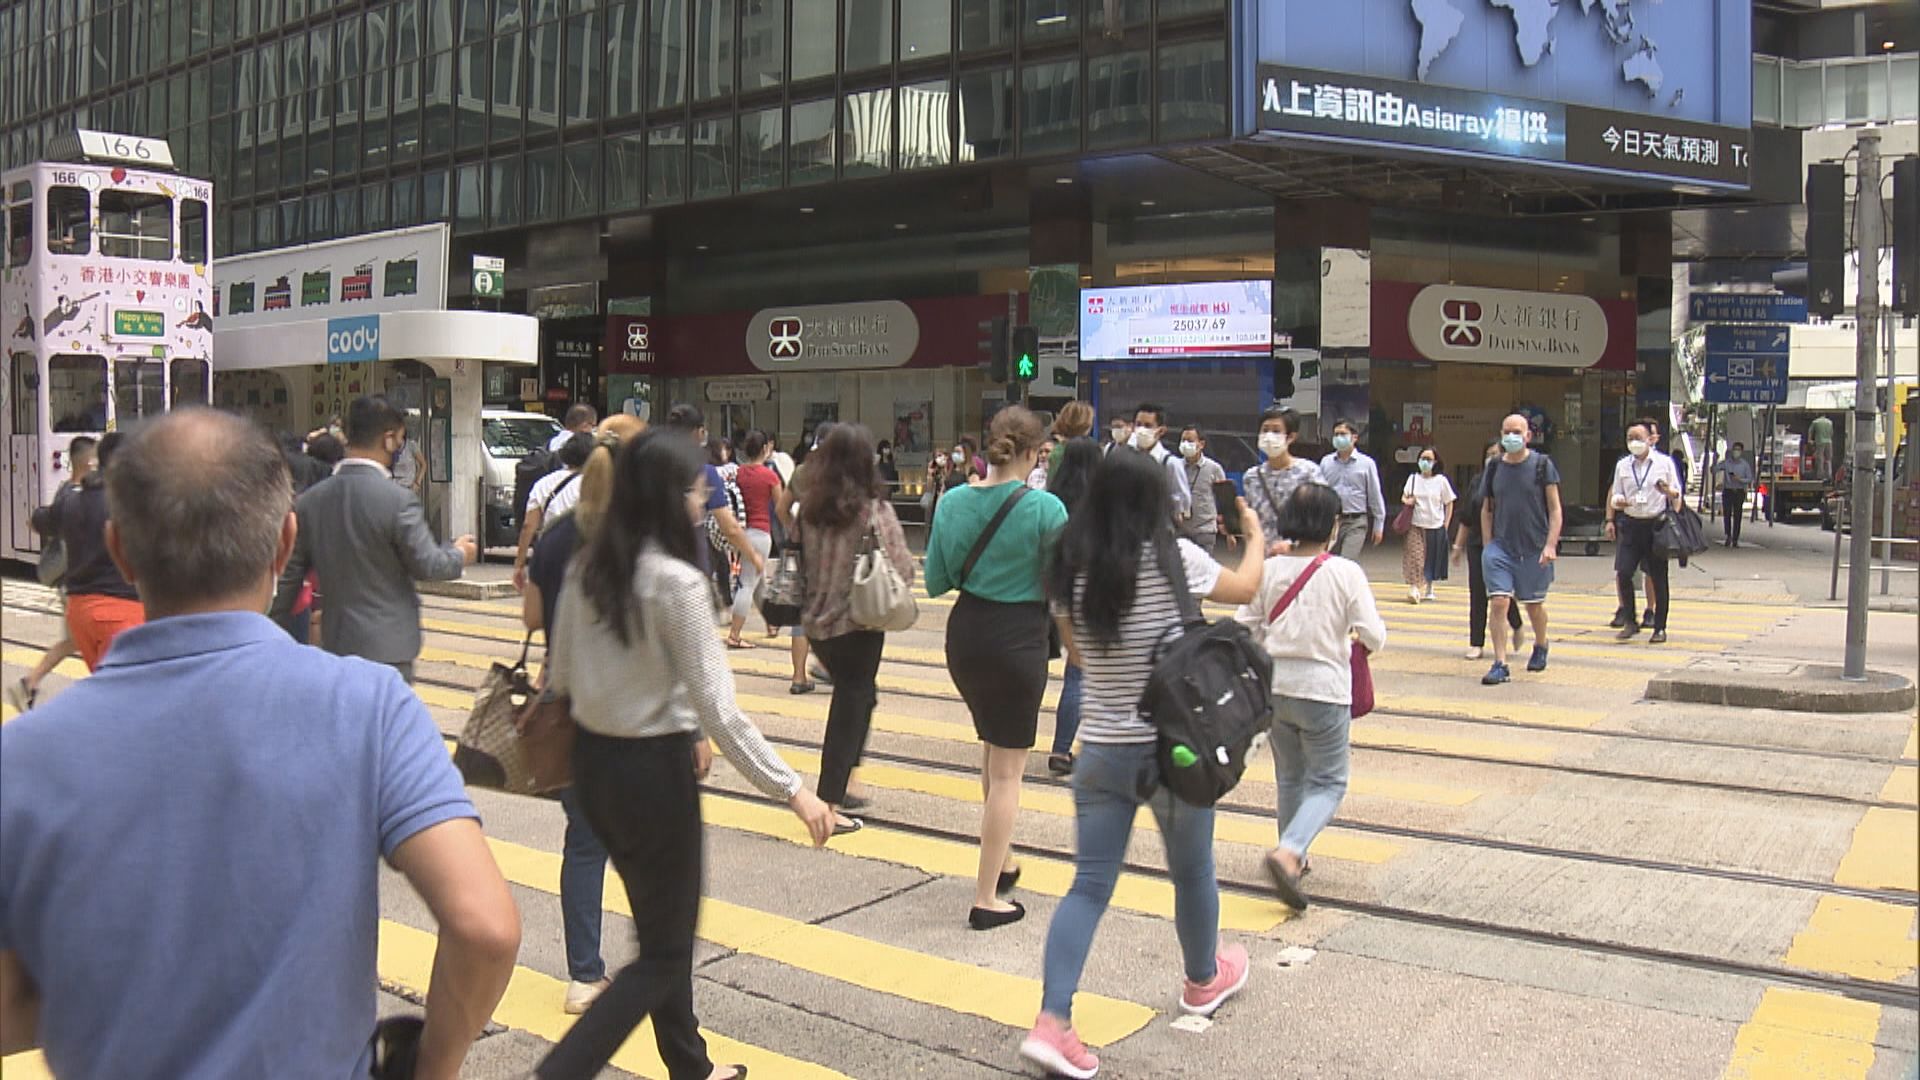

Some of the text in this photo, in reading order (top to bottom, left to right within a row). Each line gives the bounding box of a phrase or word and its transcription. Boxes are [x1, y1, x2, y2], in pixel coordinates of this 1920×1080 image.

[103, 135, 151, 159] 166
[1601, 125, 1720, 166] 今日天氣預測
[52, 172, 76, 184] 166
[194, 186, 209, 200] 166
[81, 265, 190, 289] 香港小交響樂團
[1213, 301, 1231, 314] HSI
[1706, 296, 1803, 306] Airport Express Station
[1491, 303, 1582, 331] 大新銀行
[805, 314, 889, 339] 大新銀行
[1173, 318, 1227, 331] 25037.69
[329, 324, 378, 354] cody
[621, 350, 656, 363] 大新銀行
[1728, 378, 1762, 387] Kowloon
